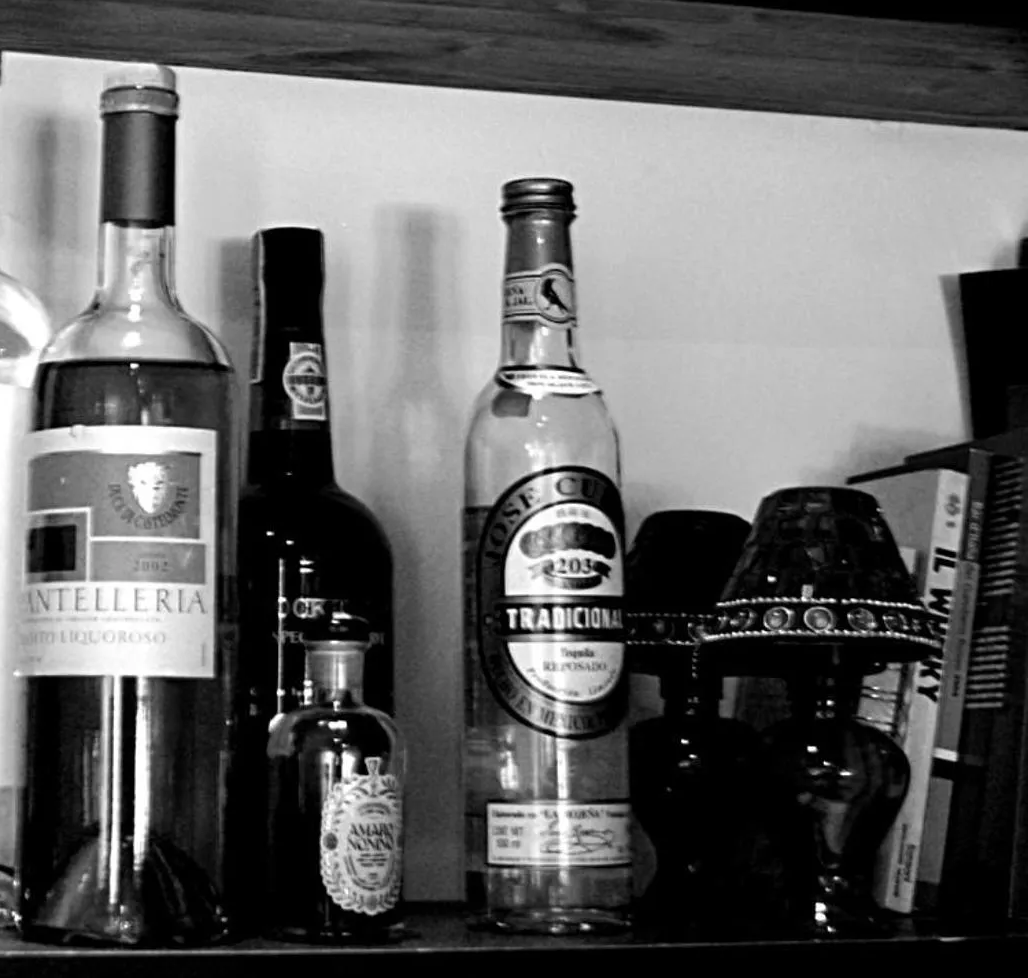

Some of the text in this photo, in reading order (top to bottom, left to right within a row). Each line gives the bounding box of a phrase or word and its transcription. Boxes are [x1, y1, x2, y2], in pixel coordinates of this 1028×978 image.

[932, 547, 958, 573] IL
[26, 587, 209, 615] ANTELLERIA
[60, 629, 168, 646] LIQUOROSO
